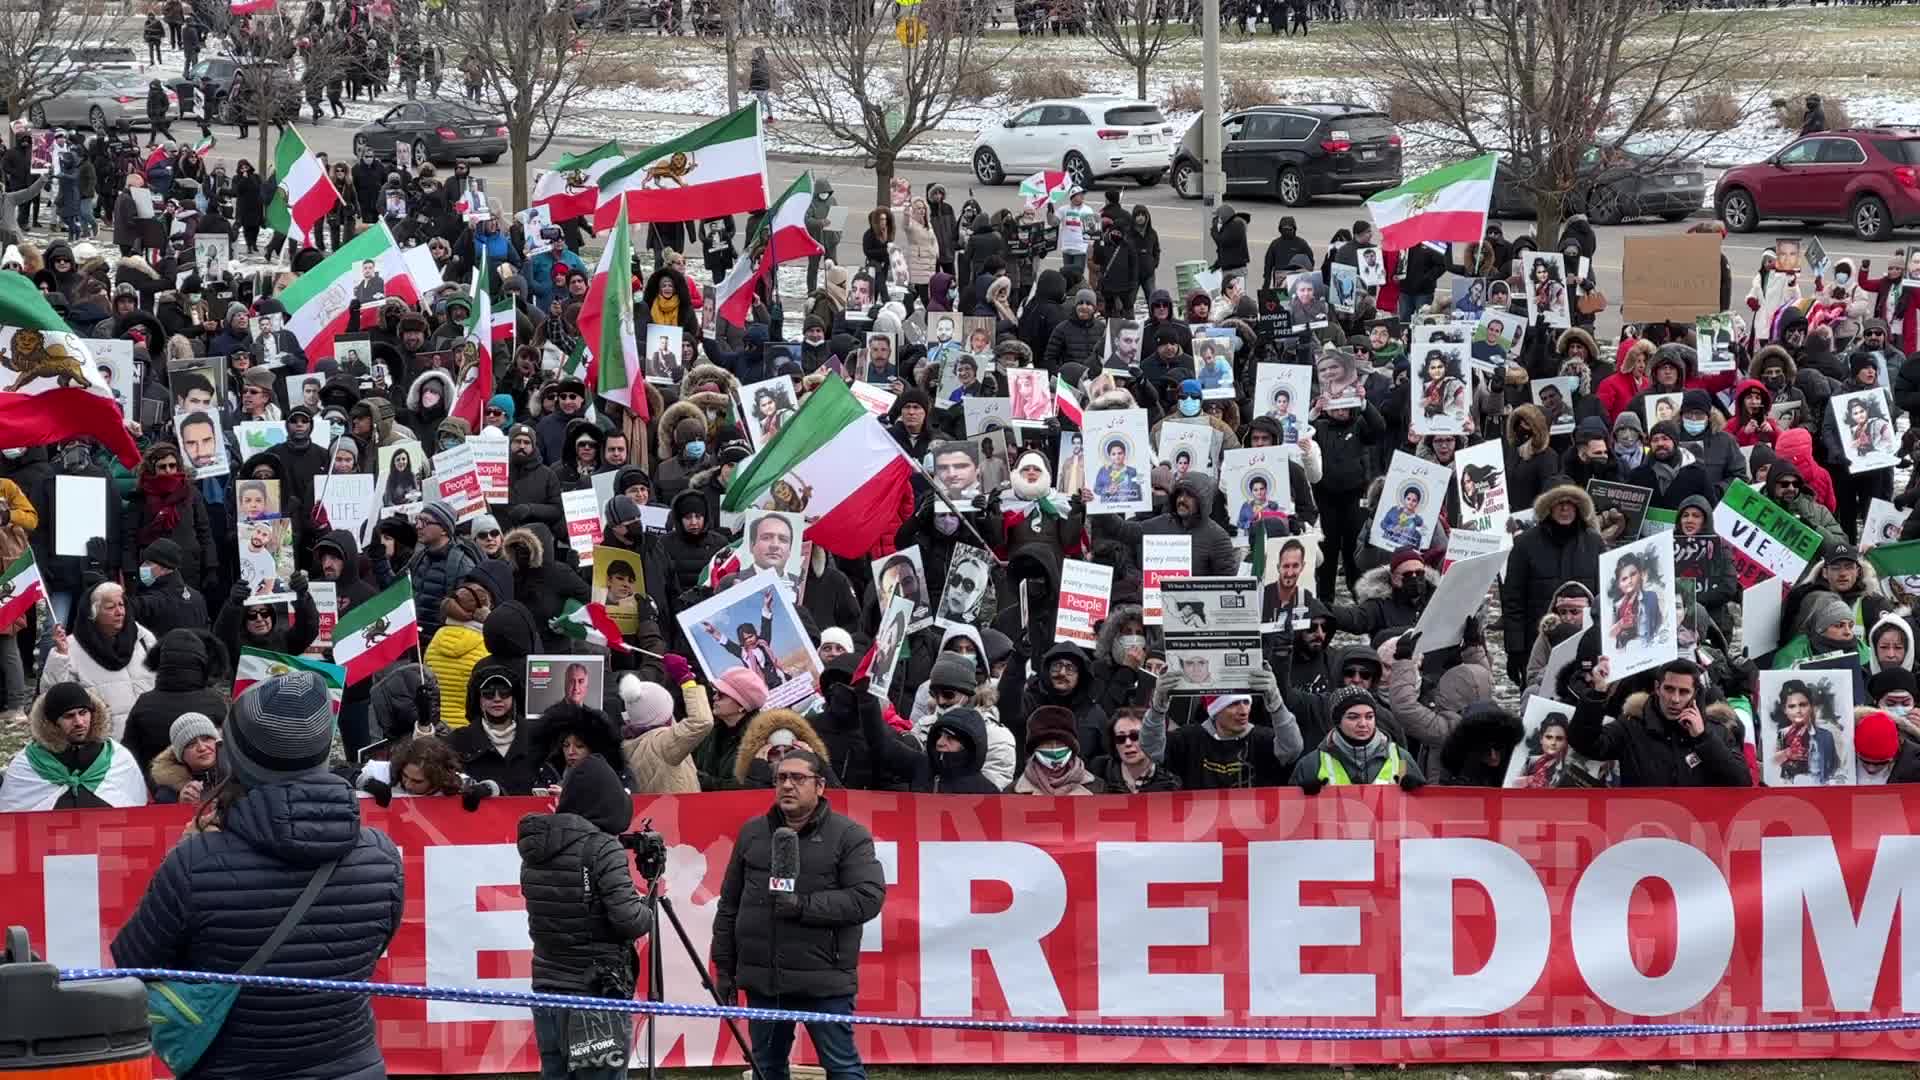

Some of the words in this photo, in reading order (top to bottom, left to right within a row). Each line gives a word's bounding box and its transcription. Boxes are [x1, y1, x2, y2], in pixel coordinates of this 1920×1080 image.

[1741, 495, 1813, 554] FEMME
[1067, 594, 1103, 611] People
[570, 1045, 590, 1057] NEW
[591, 1038, 616, 1051] YORK
